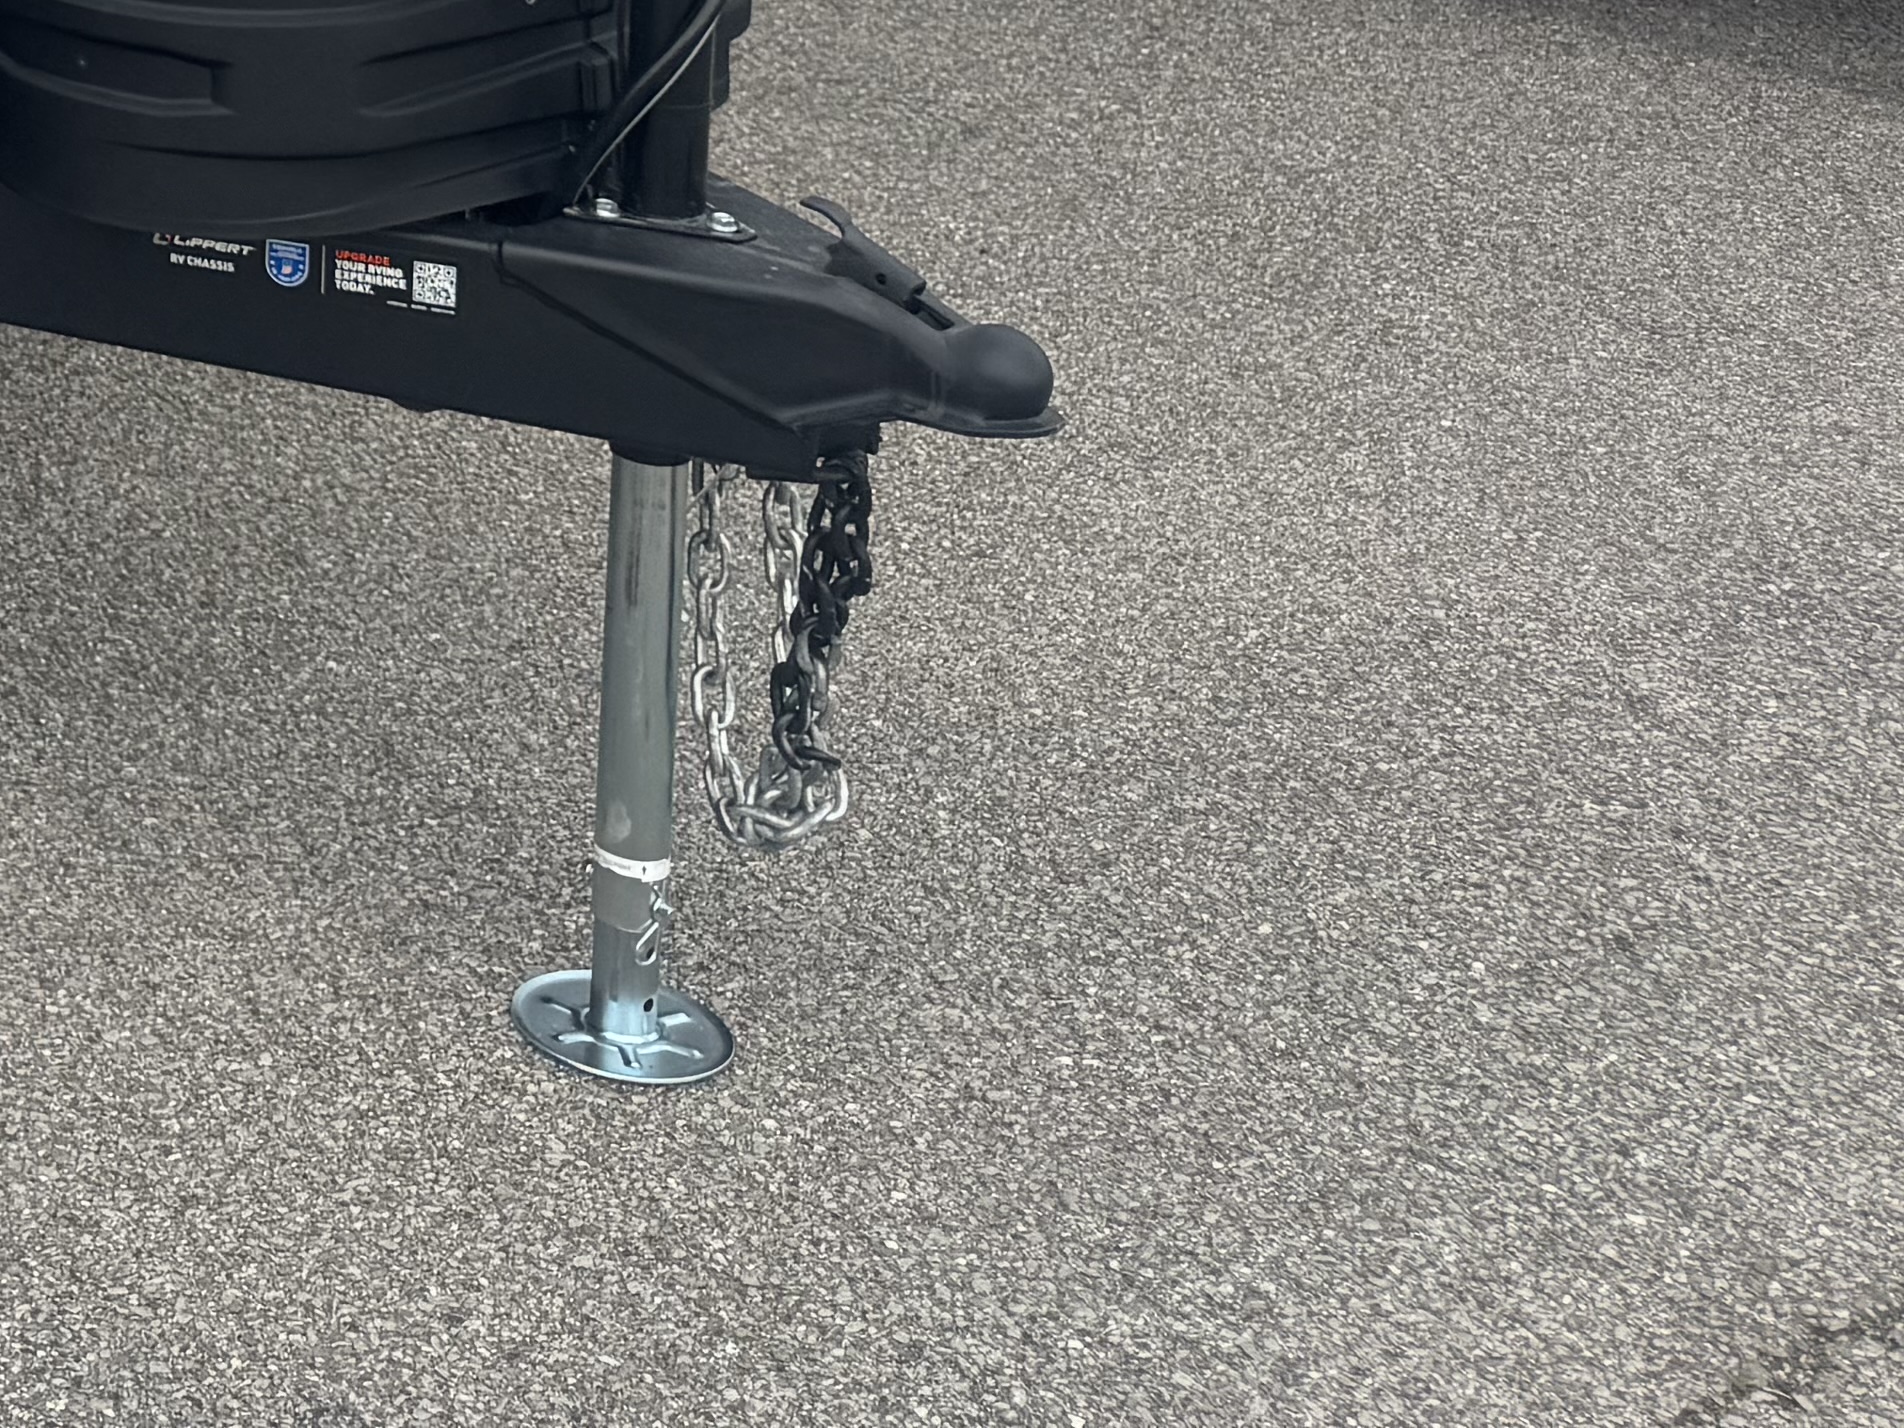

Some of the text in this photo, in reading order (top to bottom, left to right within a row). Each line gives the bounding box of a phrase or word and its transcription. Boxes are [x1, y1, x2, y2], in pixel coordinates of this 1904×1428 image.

[173, 234, 257, 256] LIPPERT
[170, 252, 235, 272] RV CHASSIS
[335, 250, 391, 266] UPGRADE
[335, 259, 366, 273] YOUR
[334, 269, 407, 291] EXPERIENCE
[334, 279, 375, 295] TODAY.
